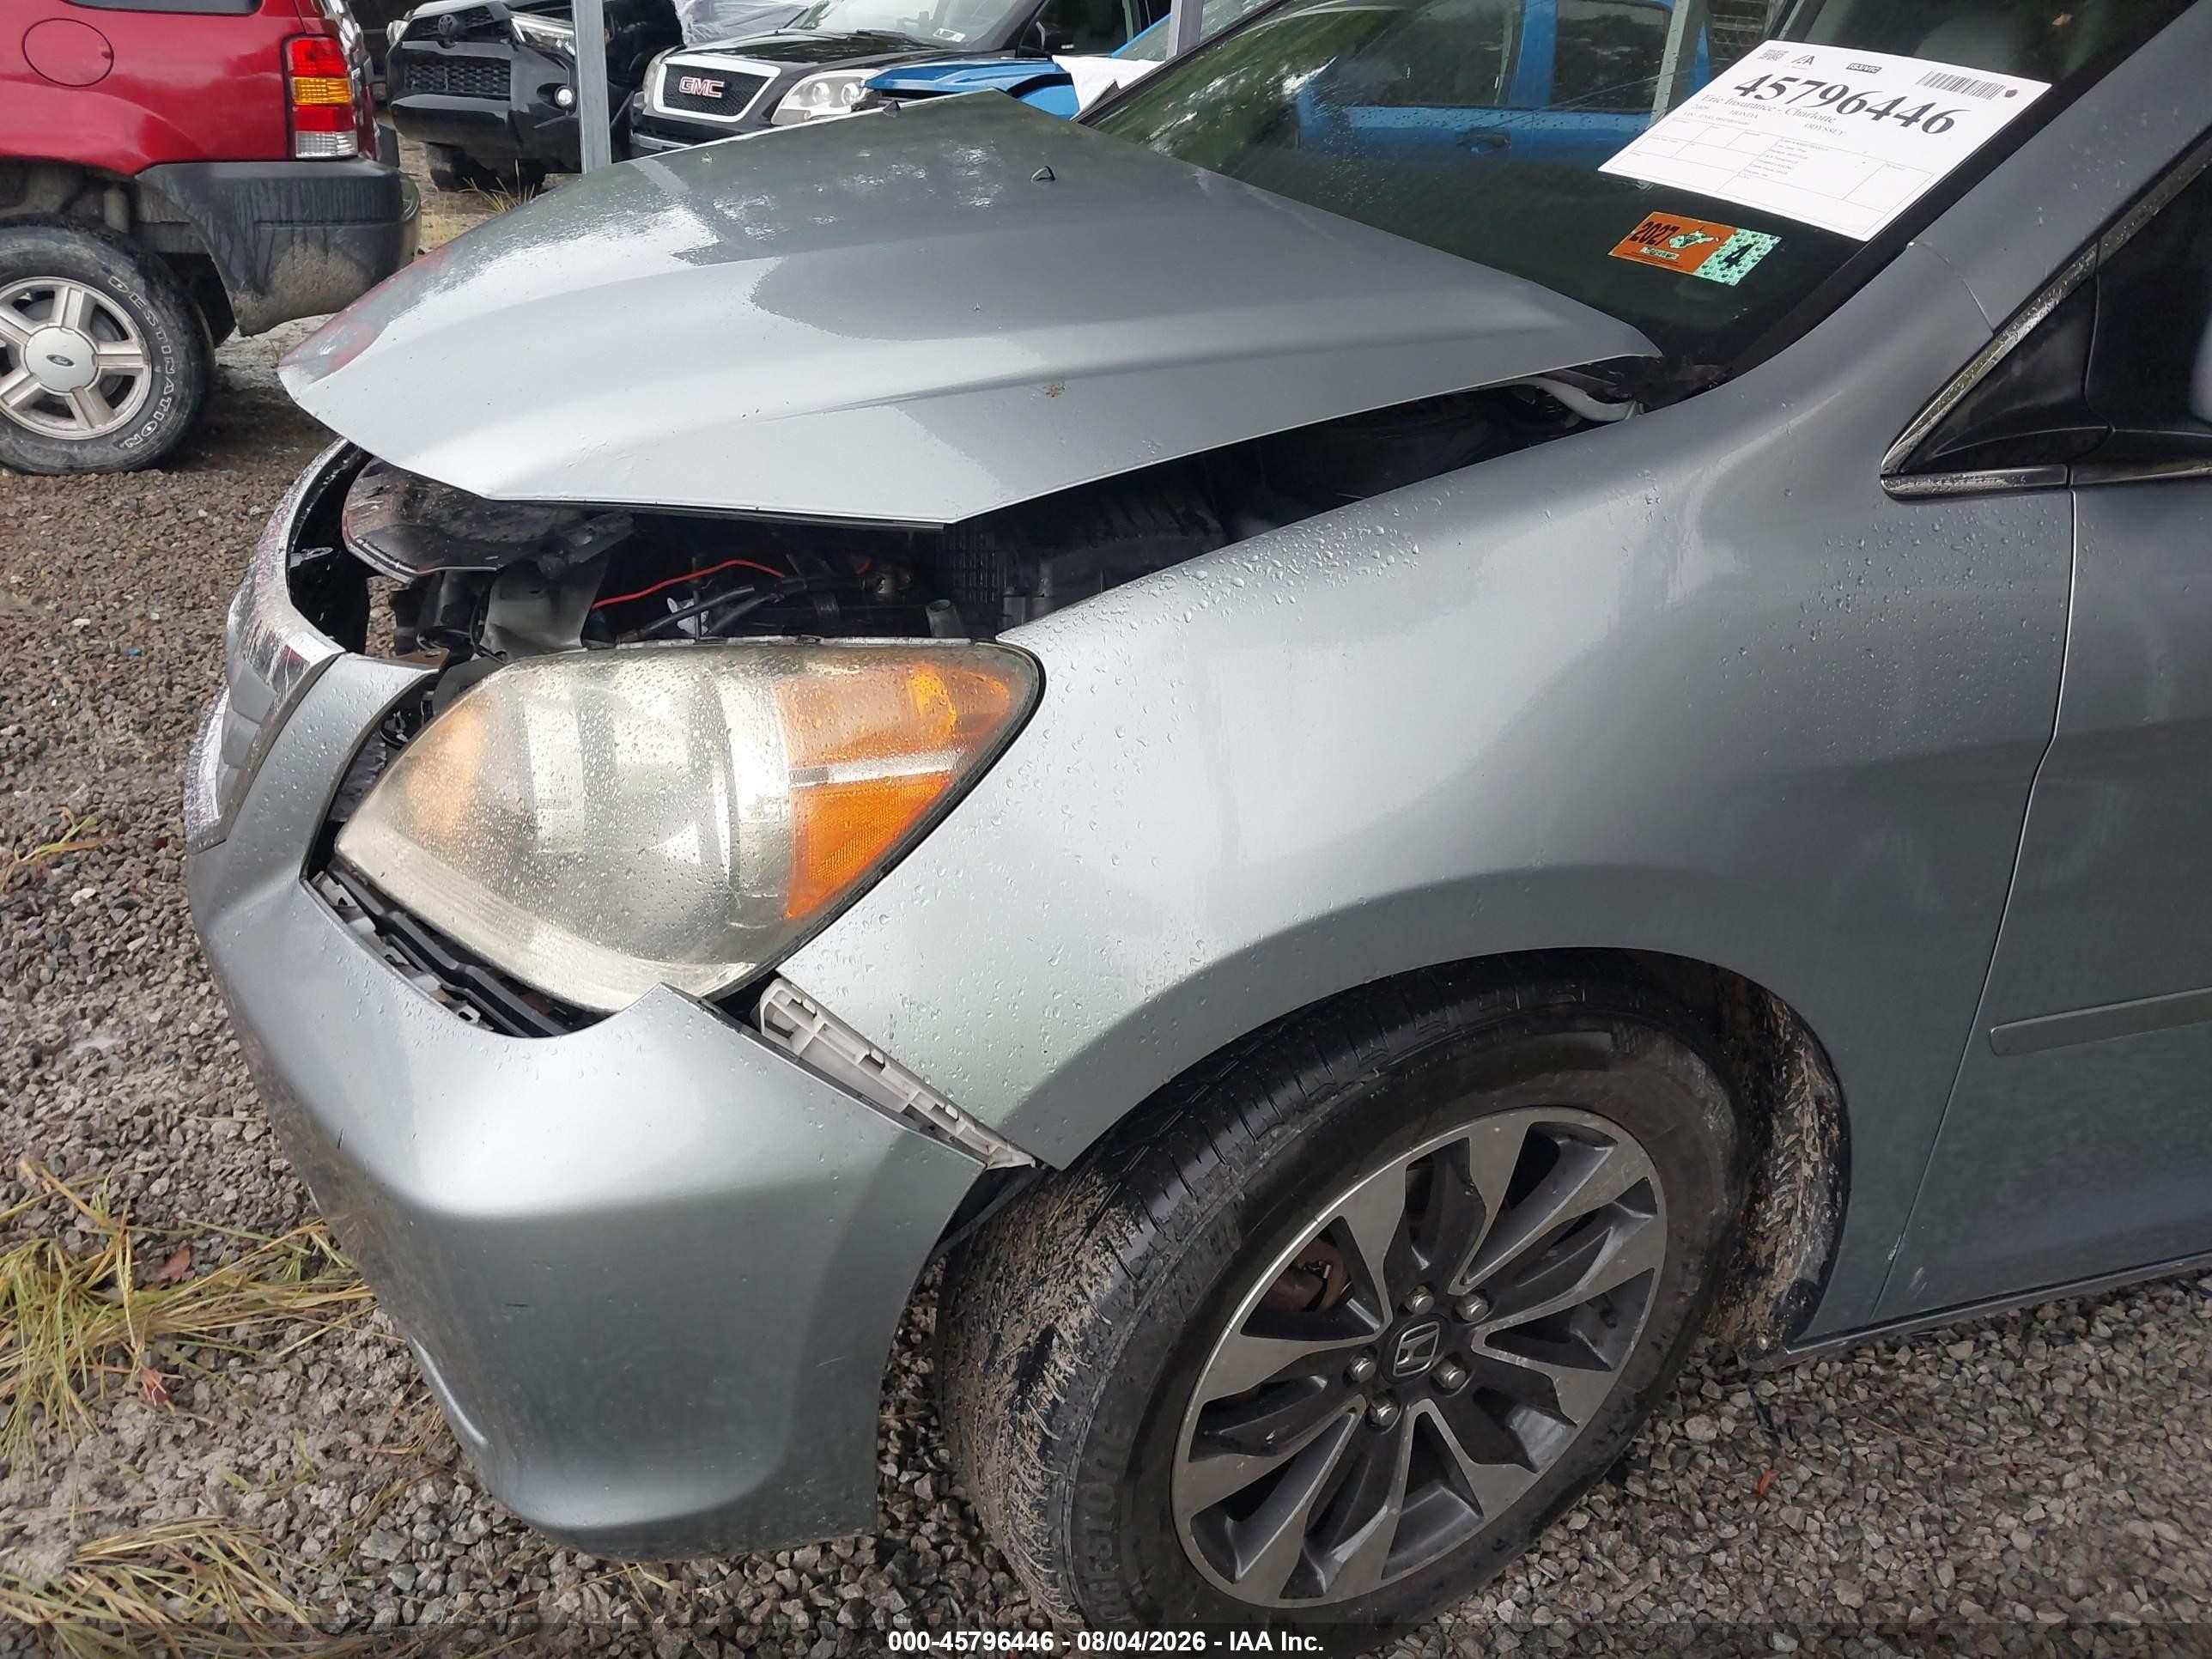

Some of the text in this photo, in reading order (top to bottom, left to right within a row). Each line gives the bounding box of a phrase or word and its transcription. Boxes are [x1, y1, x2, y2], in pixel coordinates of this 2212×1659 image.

[679, 76, 725, 98] GMC
[1702, 94, 1723, 104] Erie
[1724, 97, 1777, 112] Insurance
[1784, 107, 1837, 124] Charlotte
[1733, 74, 1972, 135] 45796446
[1628, 220, 1756, 270] 2027 4
[108, 276, 174, 448] DESTINATION
